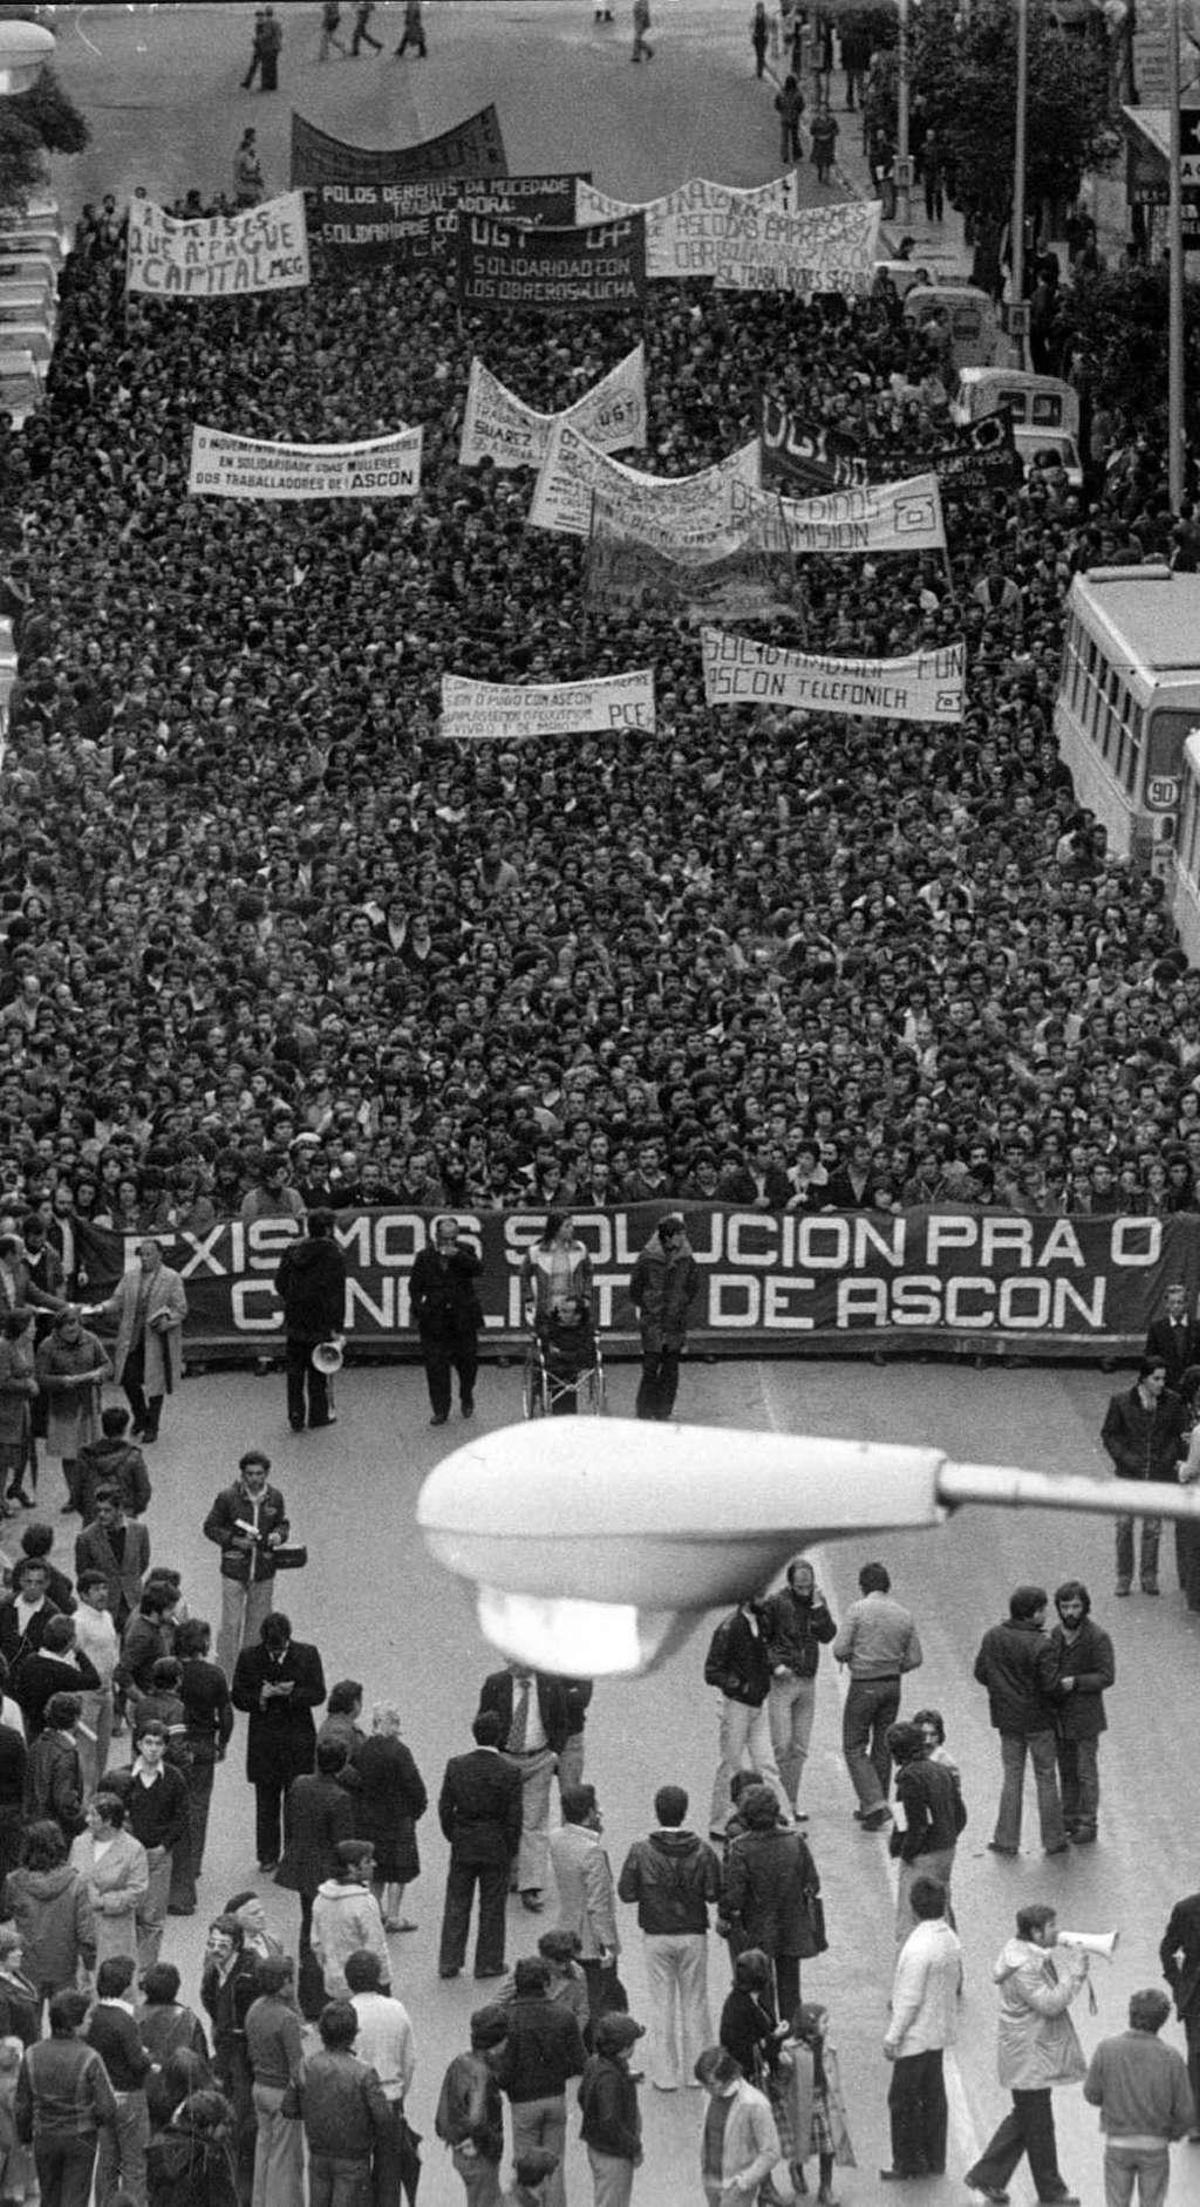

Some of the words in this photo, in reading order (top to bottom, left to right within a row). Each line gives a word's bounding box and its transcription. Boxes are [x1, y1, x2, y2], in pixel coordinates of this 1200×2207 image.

[208, 222, 294, 261] PAGUE
[142, 255, 266, 292] CAPITAL
[473, 255, 593, 279] SOLIDARIDAD
[464, 279, 495, 299] LOS
[474, 419, 533, 447] SUAREZ
[196, 472, 221, 485] DOS
[352, 470, 413, 490] ASCON
[709, 667, 787, 697] ASCON
[608, 702, 646, 727] PCE
[926, 1215, 1086, 1268] PRA
[1111, 1217, 1162, 1266] O
[709, 1273, 816, 1330] DE
